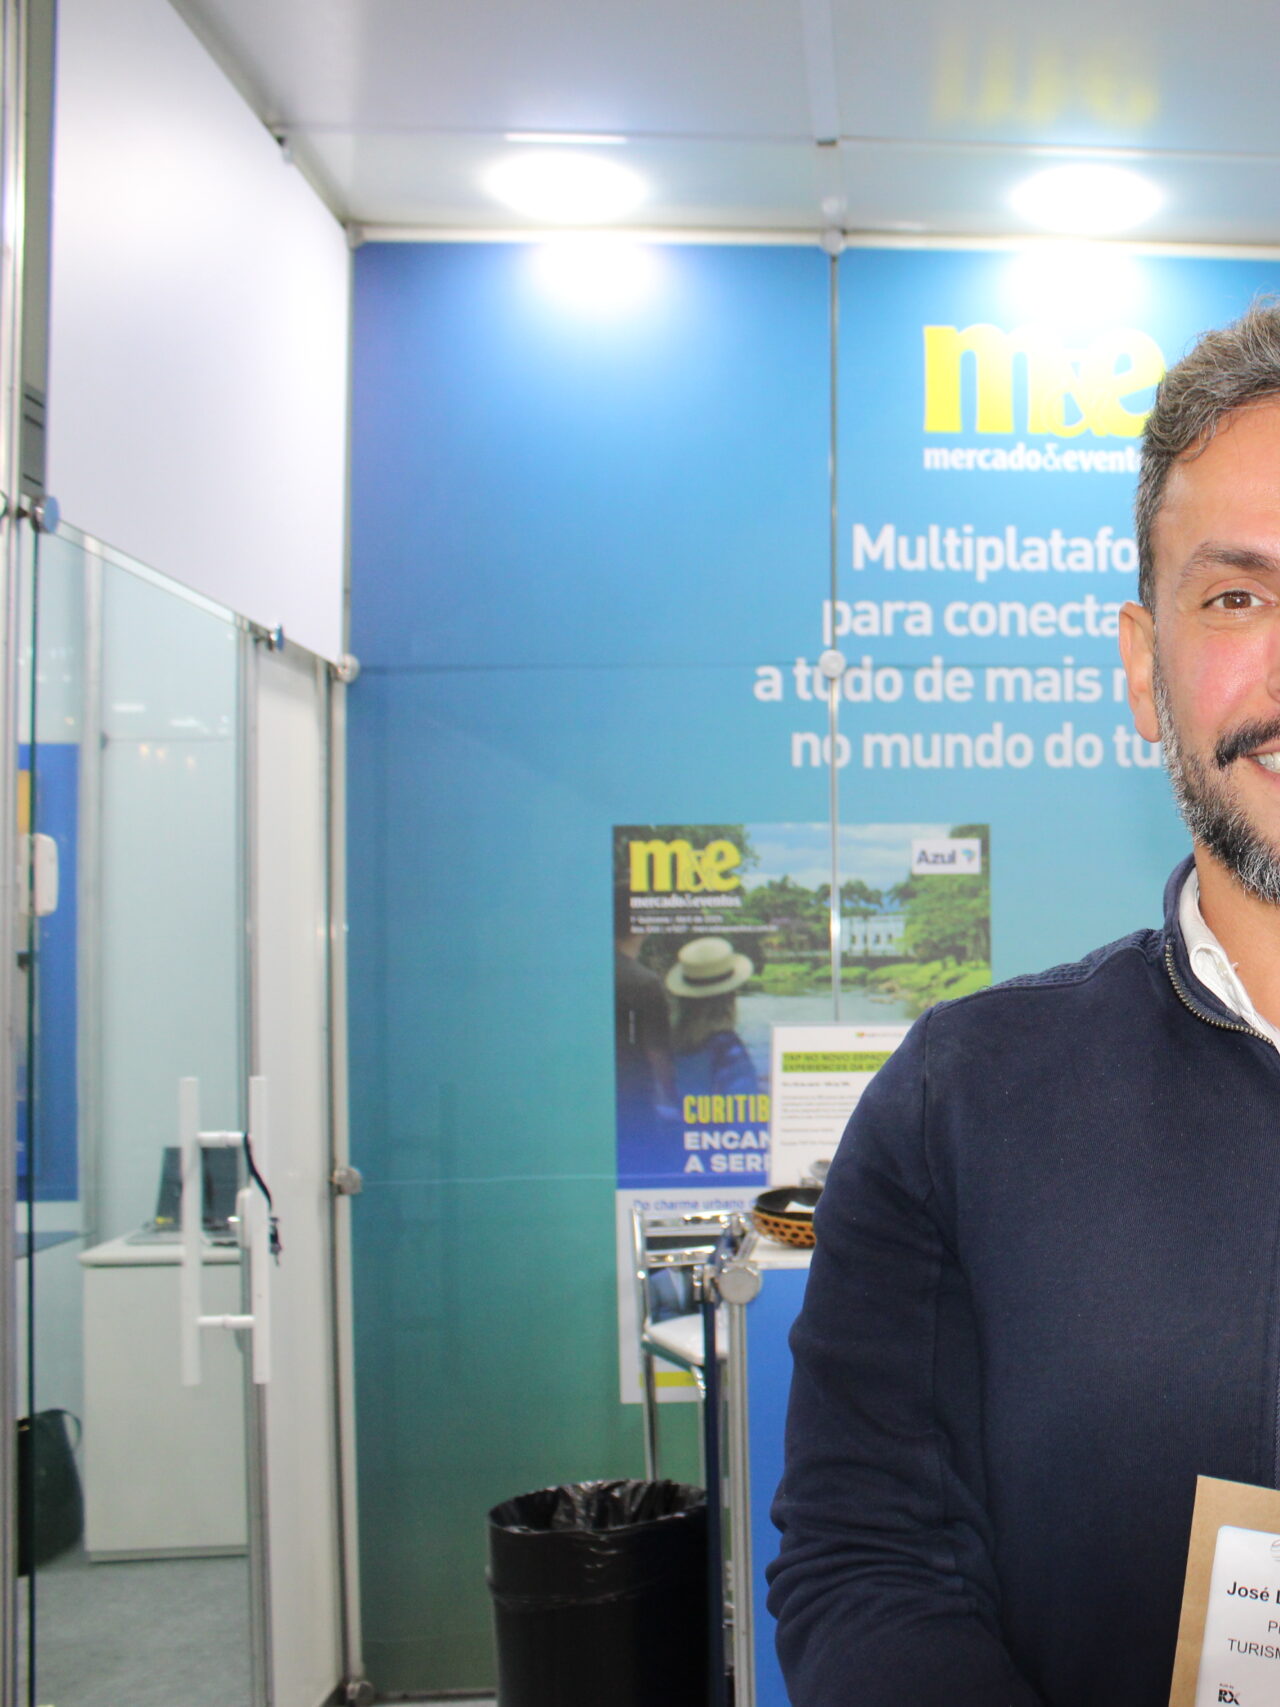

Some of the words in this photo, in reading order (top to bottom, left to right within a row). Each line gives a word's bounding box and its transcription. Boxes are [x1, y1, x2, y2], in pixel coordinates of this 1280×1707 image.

[853, 524, 1139, 582] Multiplatafo
[823, 599, 932, 646] para
[753, 665, 783, 702] a
[792, 655, 903, 702] tudo
[914, 656, 975, 702] de
[985, 656, 1103, 703] mais
[791, 731, 852, 768] no
[862, 723, 1034, 768] mundo
[1045, 723, 1103, 768] do
[629, 839, 741, 893] m&e
[916, 849, 957, 865] Azul
[683, 1093, 770, 1125] CURITIB
[684, 1154, 705, 1174] A
[1227, 1581, 1270, 1602] José
